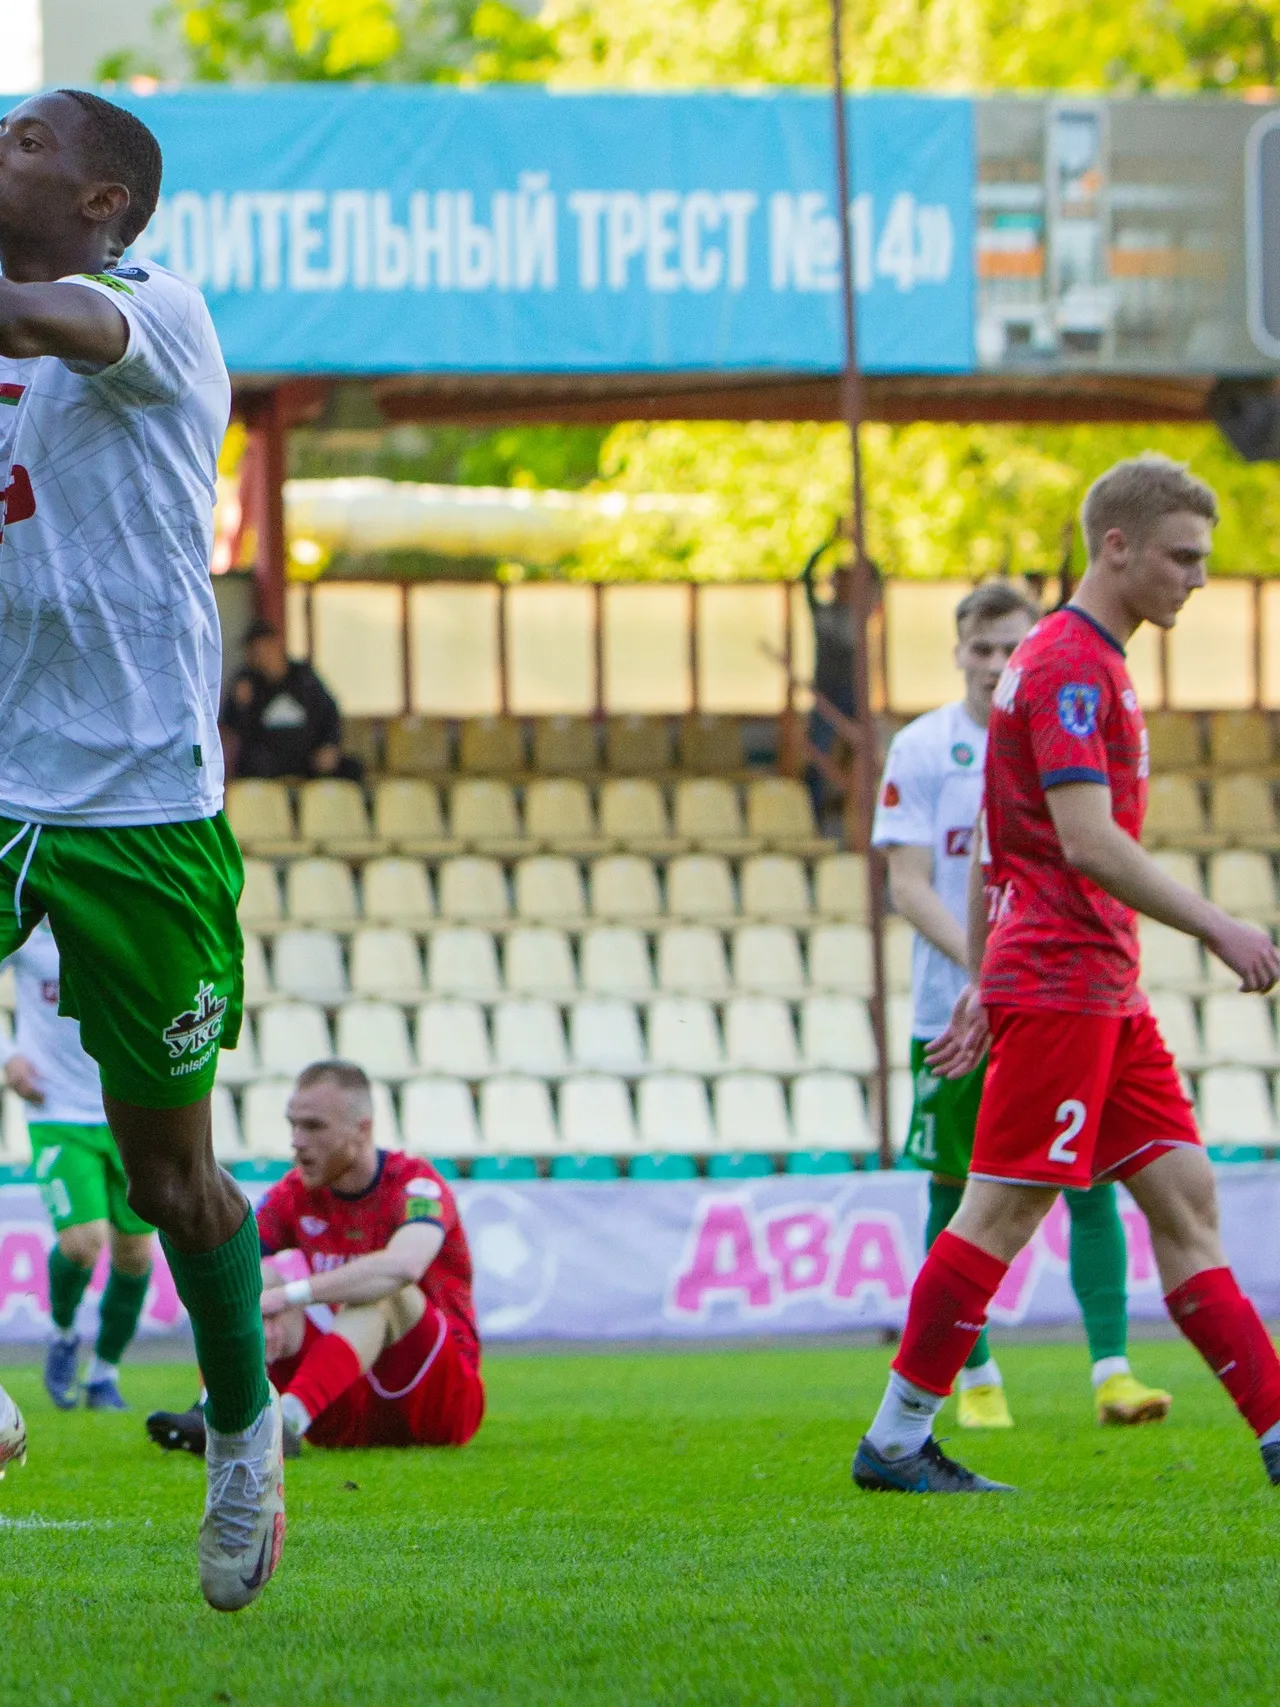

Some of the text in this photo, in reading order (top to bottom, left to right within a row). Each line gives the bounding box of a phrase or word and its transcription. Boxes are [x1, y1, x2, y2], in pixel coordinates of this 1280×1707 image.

[568, 189, 759, 293] ТРЕСТ
[170, 1041, 216, 1077] uhlsport
[1047, 1100, 1087, 1164] 2
